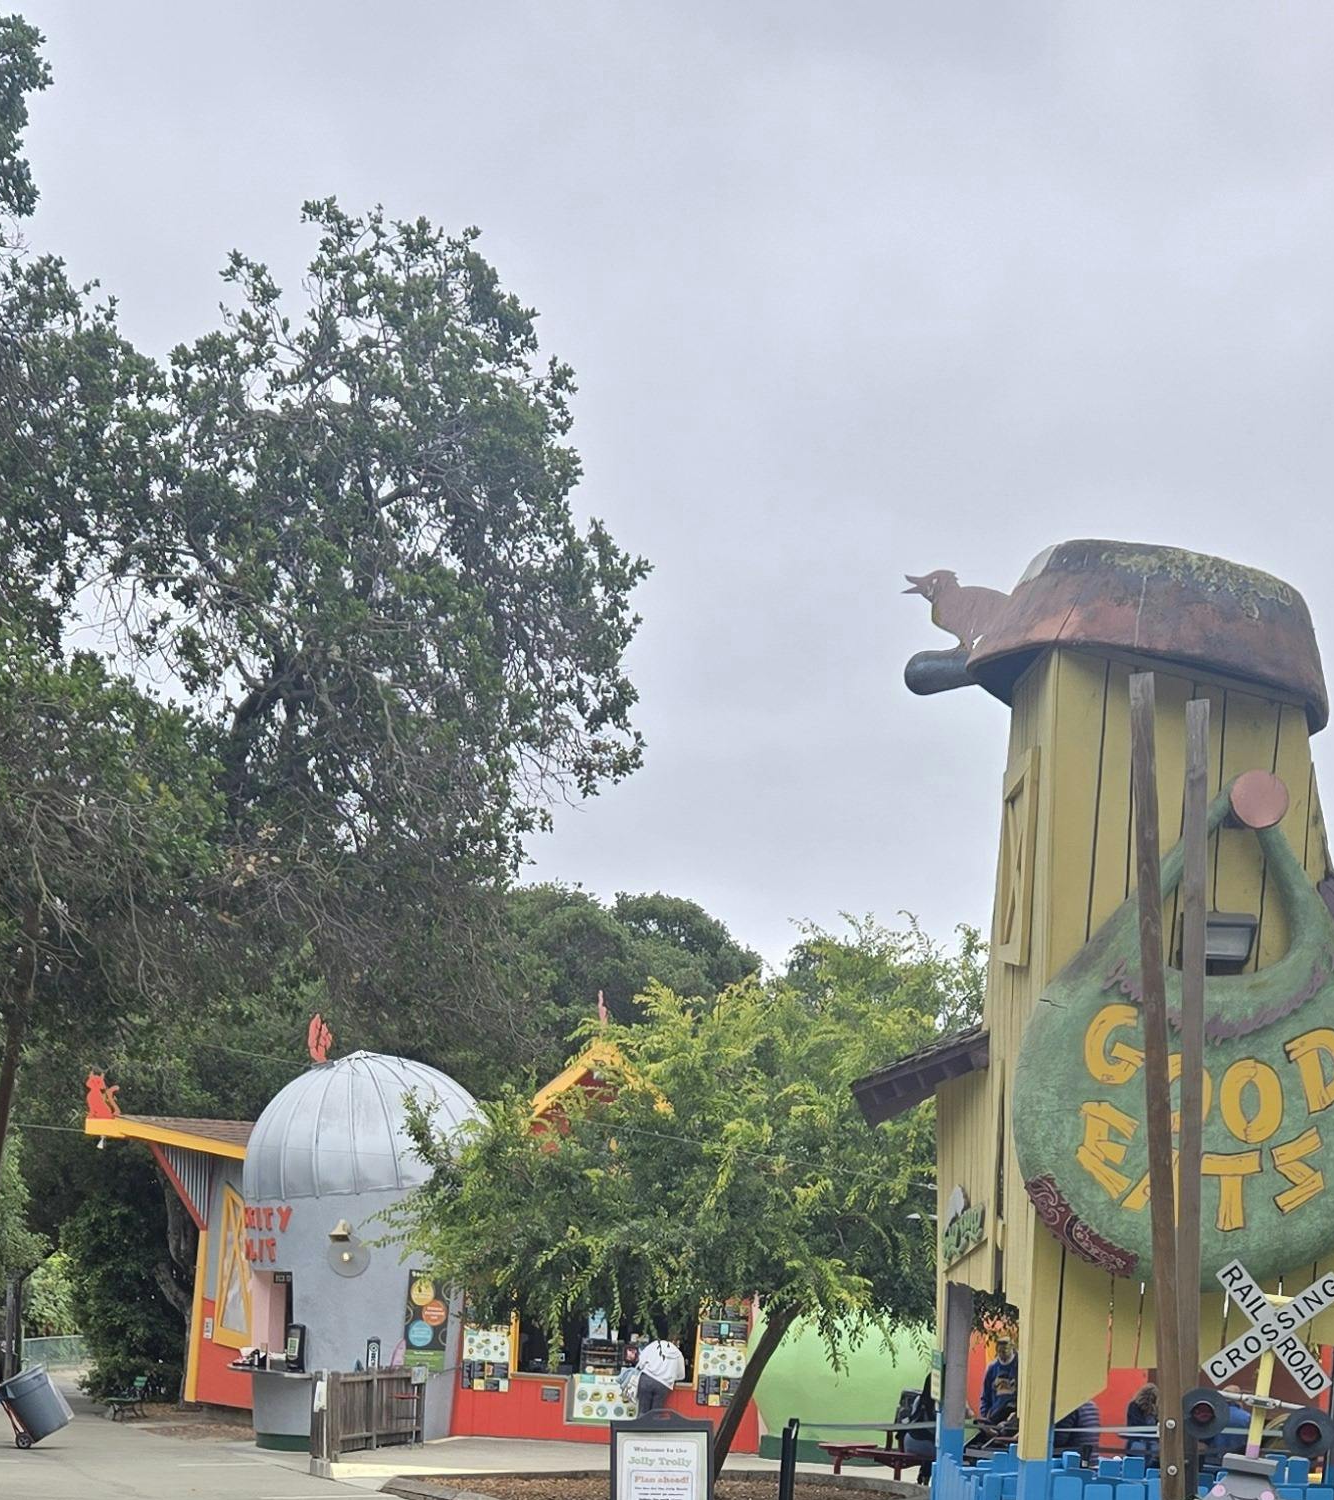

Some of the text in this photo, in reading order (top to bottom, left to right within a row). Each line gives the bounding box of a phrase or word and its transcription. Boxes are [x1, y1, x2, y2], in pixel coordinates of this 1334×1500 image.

[1221, 1265, 1324, 1390] RAIL ROAD
[627, 1456, 692, 1467] Jolly Trolly
[634, 1475, 656, 1483] Plan
